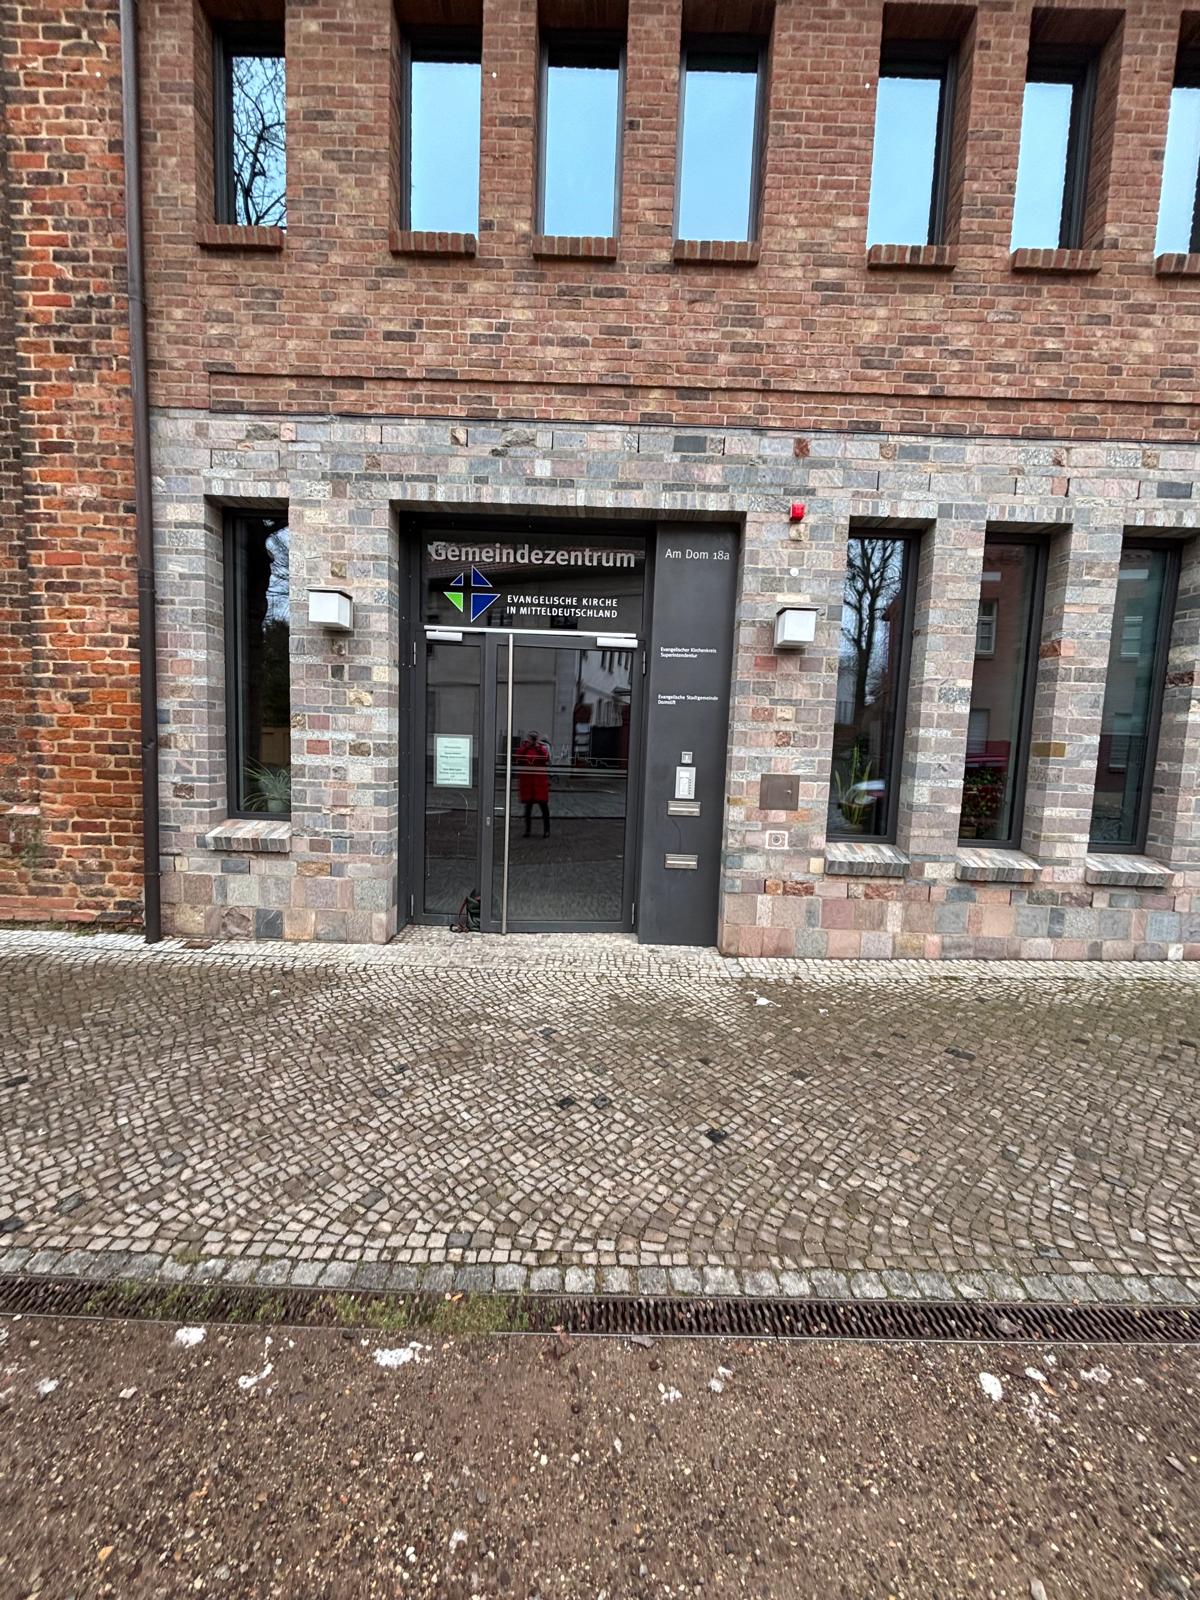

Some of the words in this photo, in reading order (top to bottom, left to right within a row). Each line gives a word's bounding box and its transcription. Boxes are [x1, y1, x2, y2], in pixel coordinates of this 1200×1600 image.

[431, 541, 635, 567] Gemeindezentrum
[665, 549, 681, 559] Am
[685, 549, 709, 560] Dom
[713, 551, 730, 560] 18a
[507, 594, 578, 606] EVANGELISCHE
[582, 597, 618, 607] KIRCHE
[506, 605, 516, 614] IN
[519, 606, 618, 618] MITTELDEUTSCHLAND
